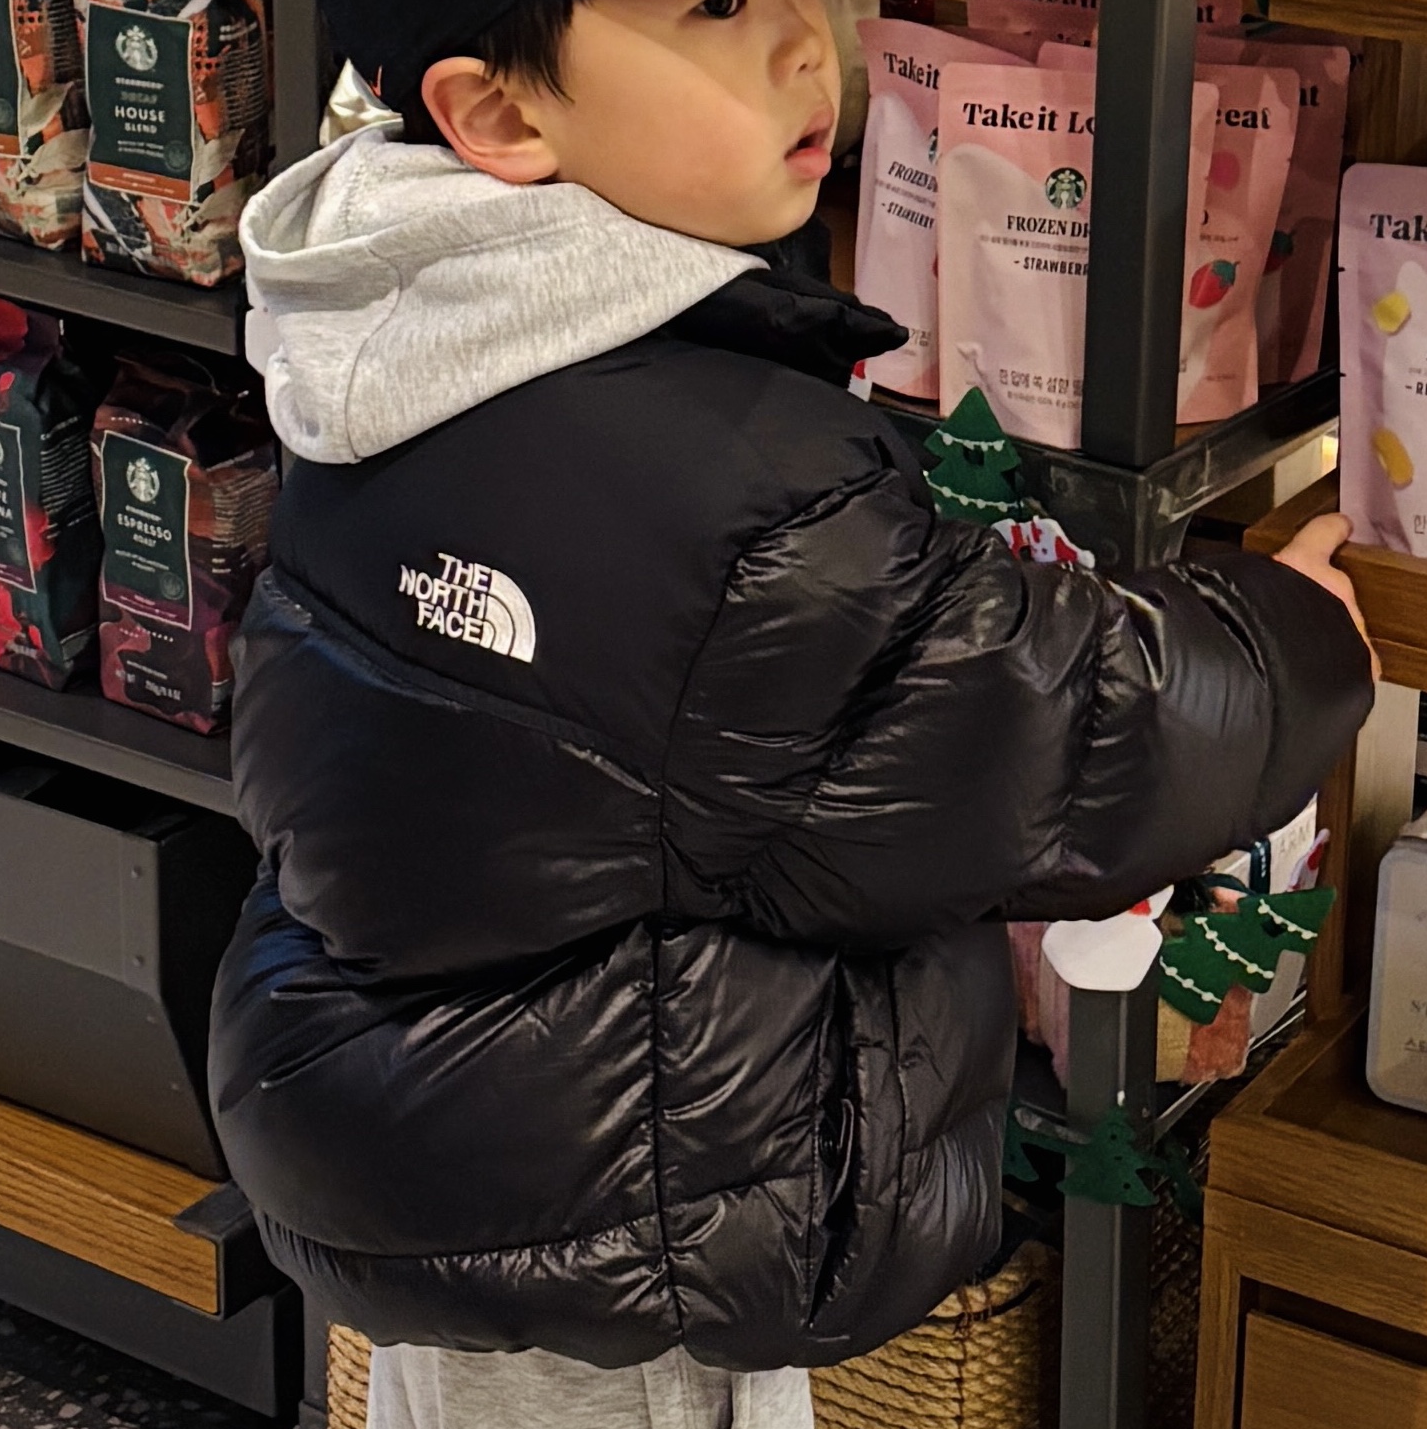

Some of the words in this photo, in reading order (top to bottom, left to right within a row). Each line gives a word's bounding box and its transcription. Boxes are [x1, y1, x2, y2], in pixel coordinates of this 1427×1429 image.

[114, 105, 166, 123] HOUSE
[124, 123, 158, 135] BLEND
[1007, 215, 1067, 237] FROZEN
[117, 513, 172, 542] ESPRESSO
[1413, 515, 1427, 535] 한
[437, 552, 492, 593] THE
[398, 564, 487, 619] NORTH
[417, 600, 484, 645] FACE
